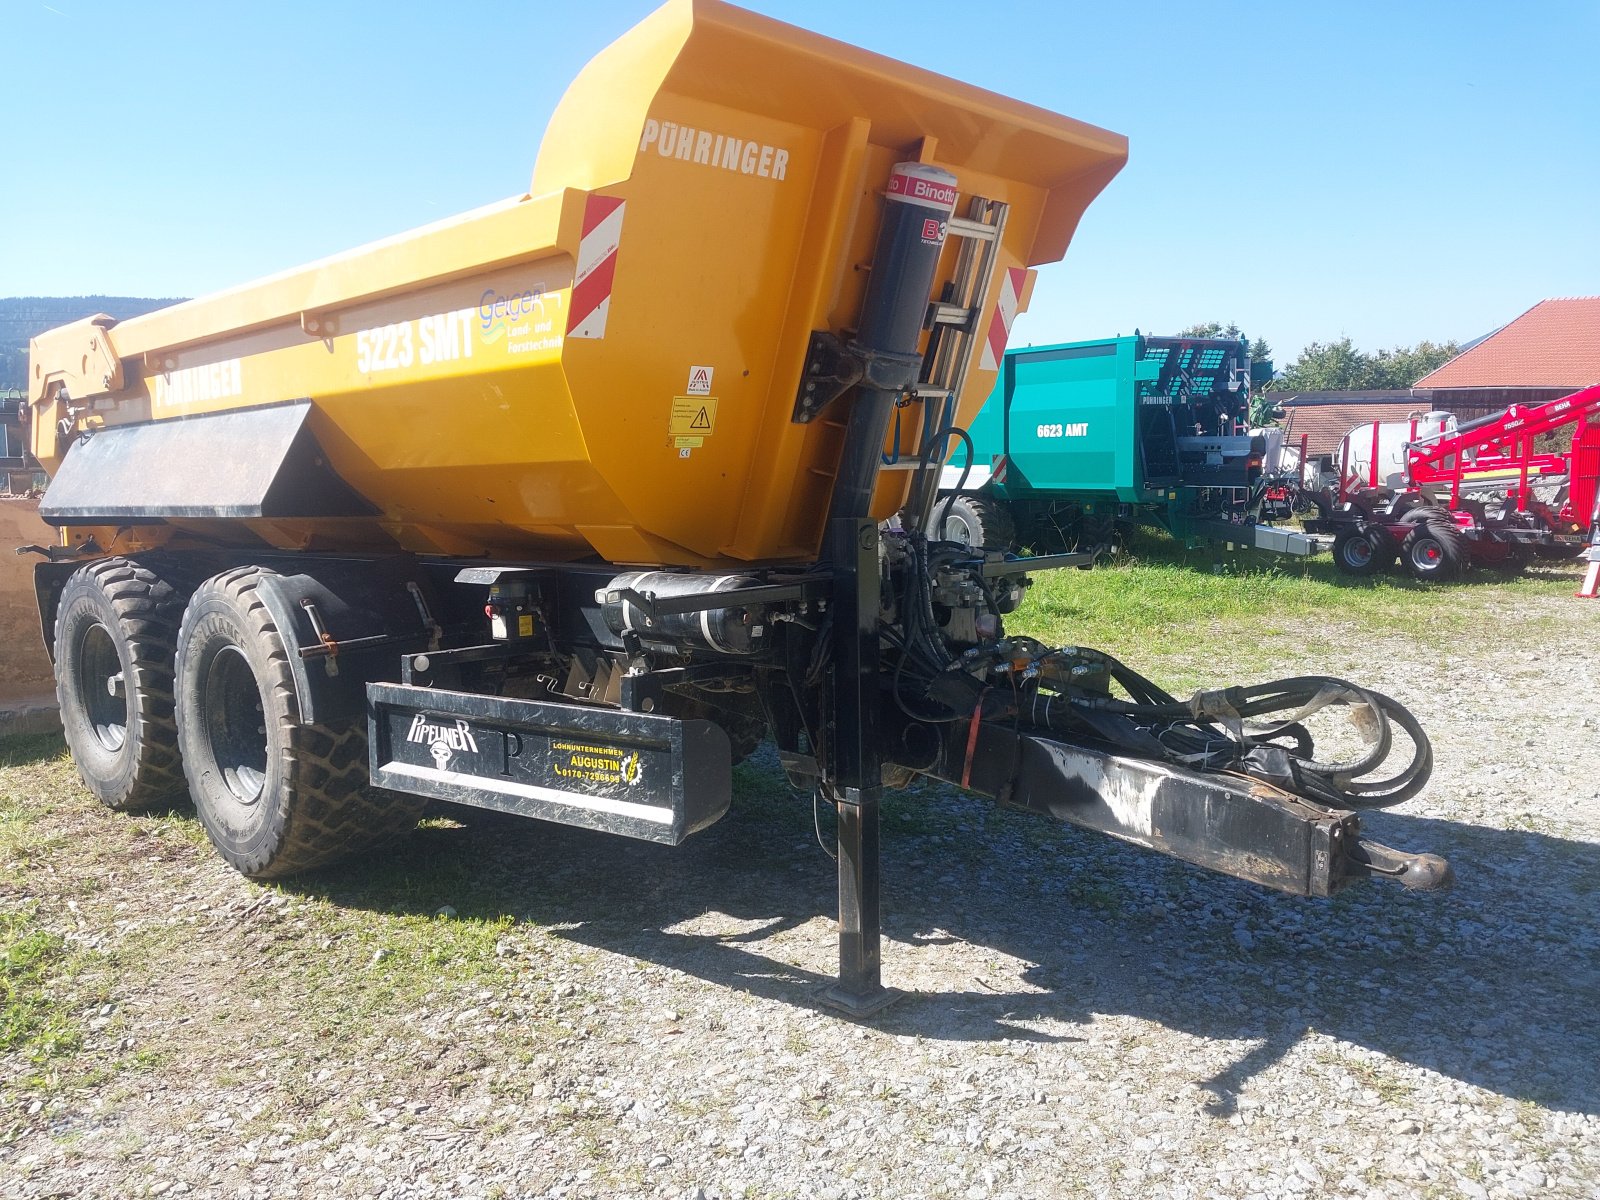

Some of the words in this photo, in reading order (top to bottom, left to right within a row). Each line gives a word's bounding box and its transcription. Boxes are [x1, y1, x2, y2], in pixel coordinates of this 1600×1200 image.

[639, 118, 790, 181] PÜHRINGER
[914, 181, 955, 203] Binotto
[357, 320, 413, 373] 5223
[419, 307, 476, 365] SMT
[507, 335, 563, 353] Forsttechnik
[1037, 424, 1063, 438] 6623
[1065, 423, 1089, 437] AMT
[553, 743, 624, 756] LOHNUNTERNEHMEN
[571, 755, 620, 771] AUGUSTIN
